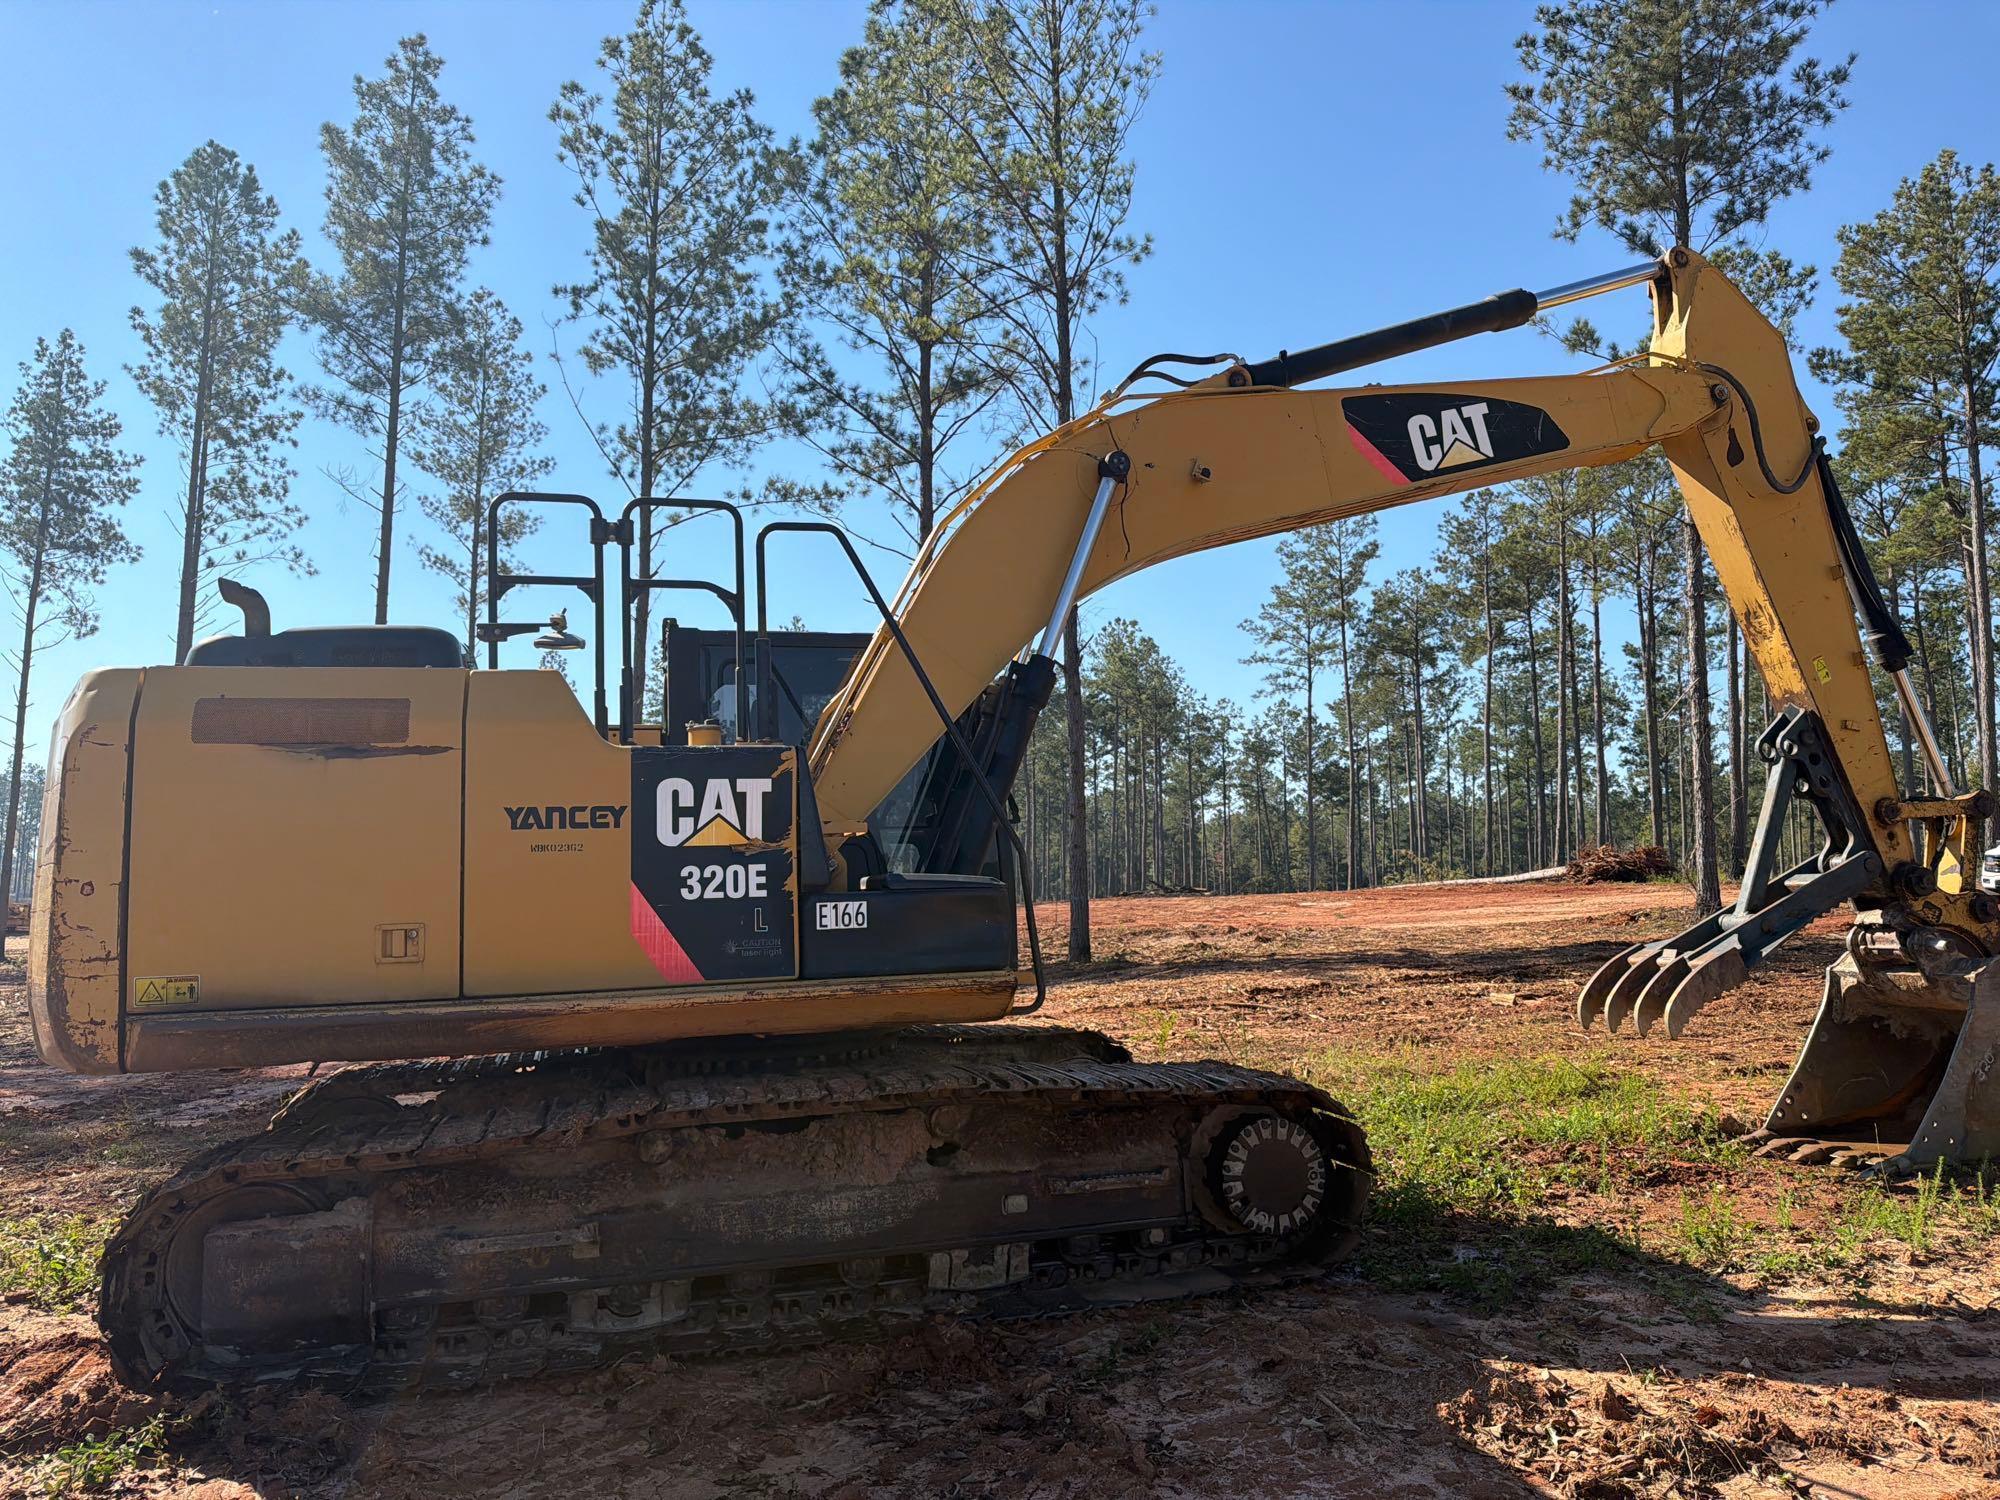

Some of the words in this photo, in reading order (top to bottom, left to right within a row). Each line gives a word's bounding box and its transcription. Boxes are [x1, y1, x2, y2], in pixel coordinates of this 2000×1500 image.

[1407, 402, 1494, 471] CAT
[503, 805, 628, 830] YANCEY
[656, 777, 772, 847] CAT
[680, 863, 768, 901] 320E
[754, 907, 769, 932] L
[818, 902, 866, 928] E166
